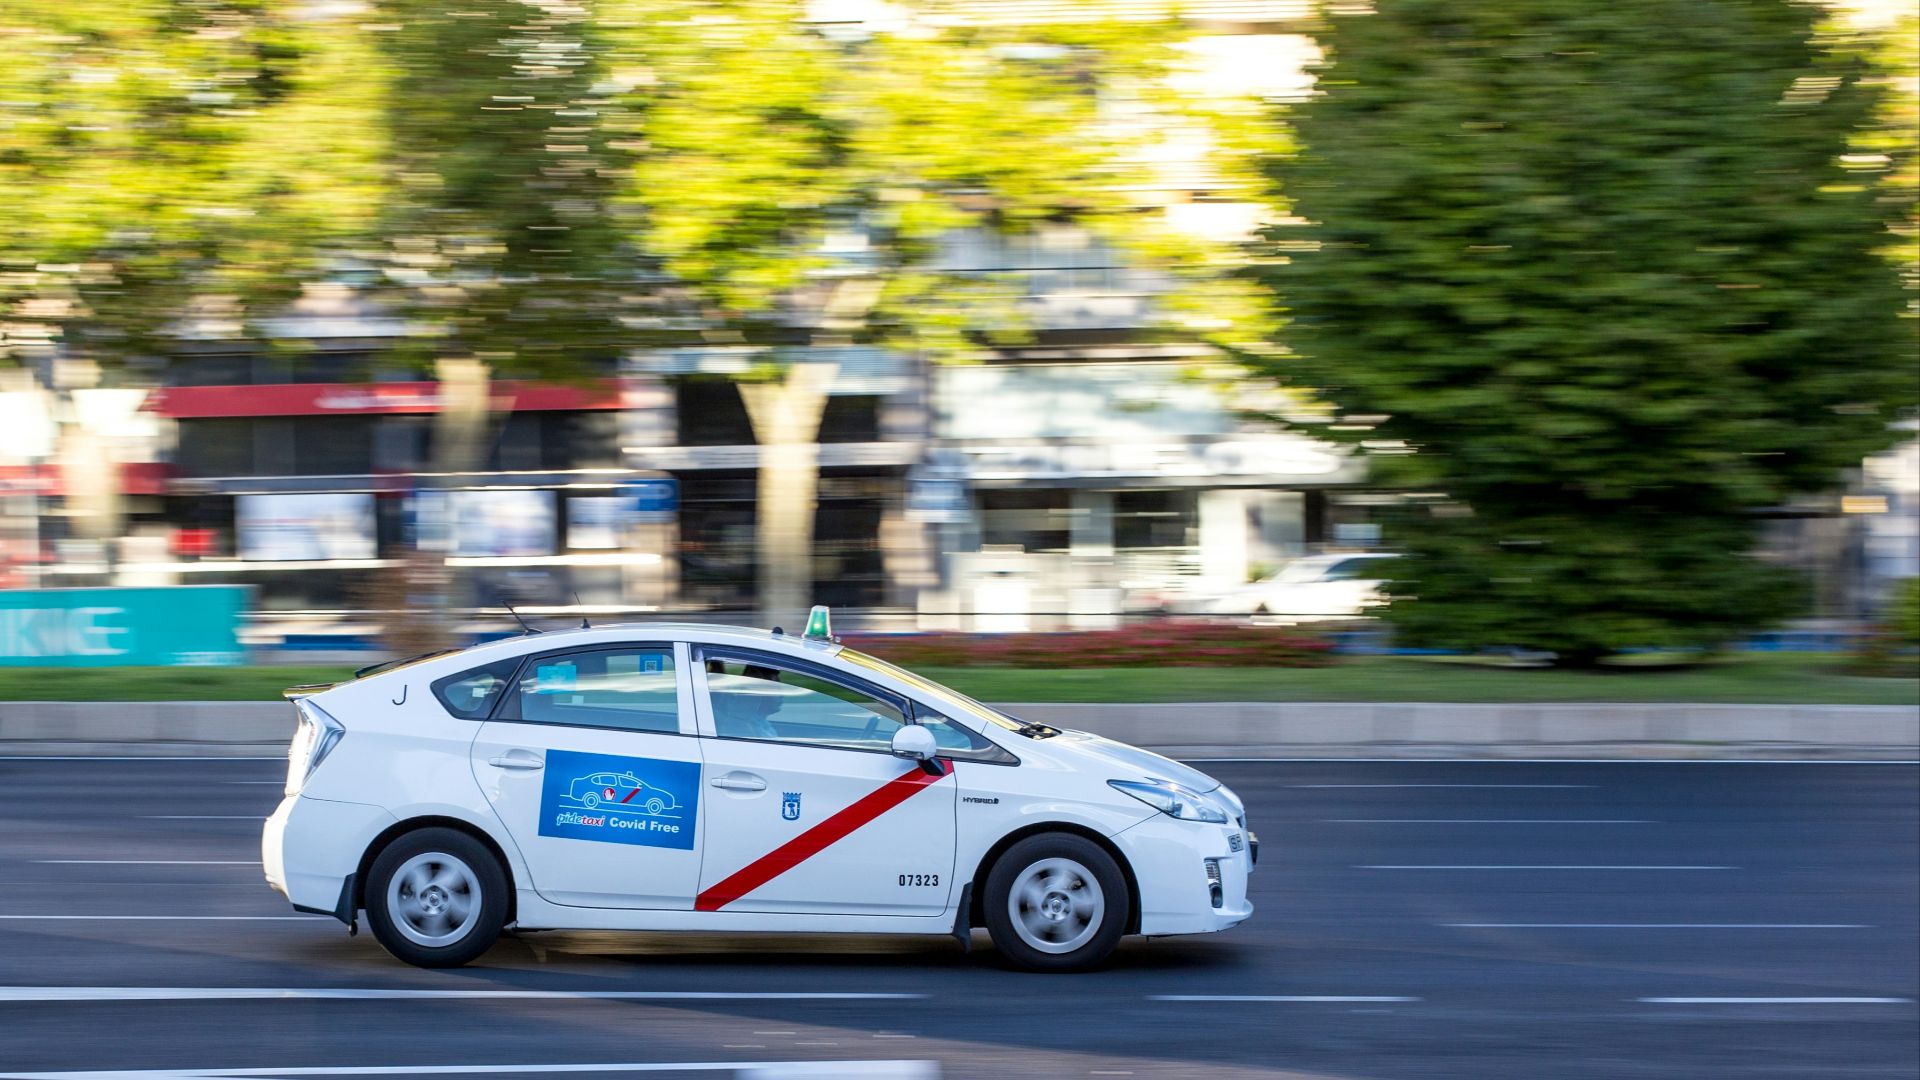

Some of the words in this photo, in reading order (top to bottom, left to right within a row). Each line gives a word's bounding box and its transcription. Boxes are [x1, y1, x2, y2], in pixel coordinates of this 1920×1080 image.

[392, 684, 408, 706] J
[556, 812, 606, 826] pidetaxi
[609, 816, 646, 830] Covid
[650, 820, 680, 833] Free
[898, 874, 939, 887] 07323
